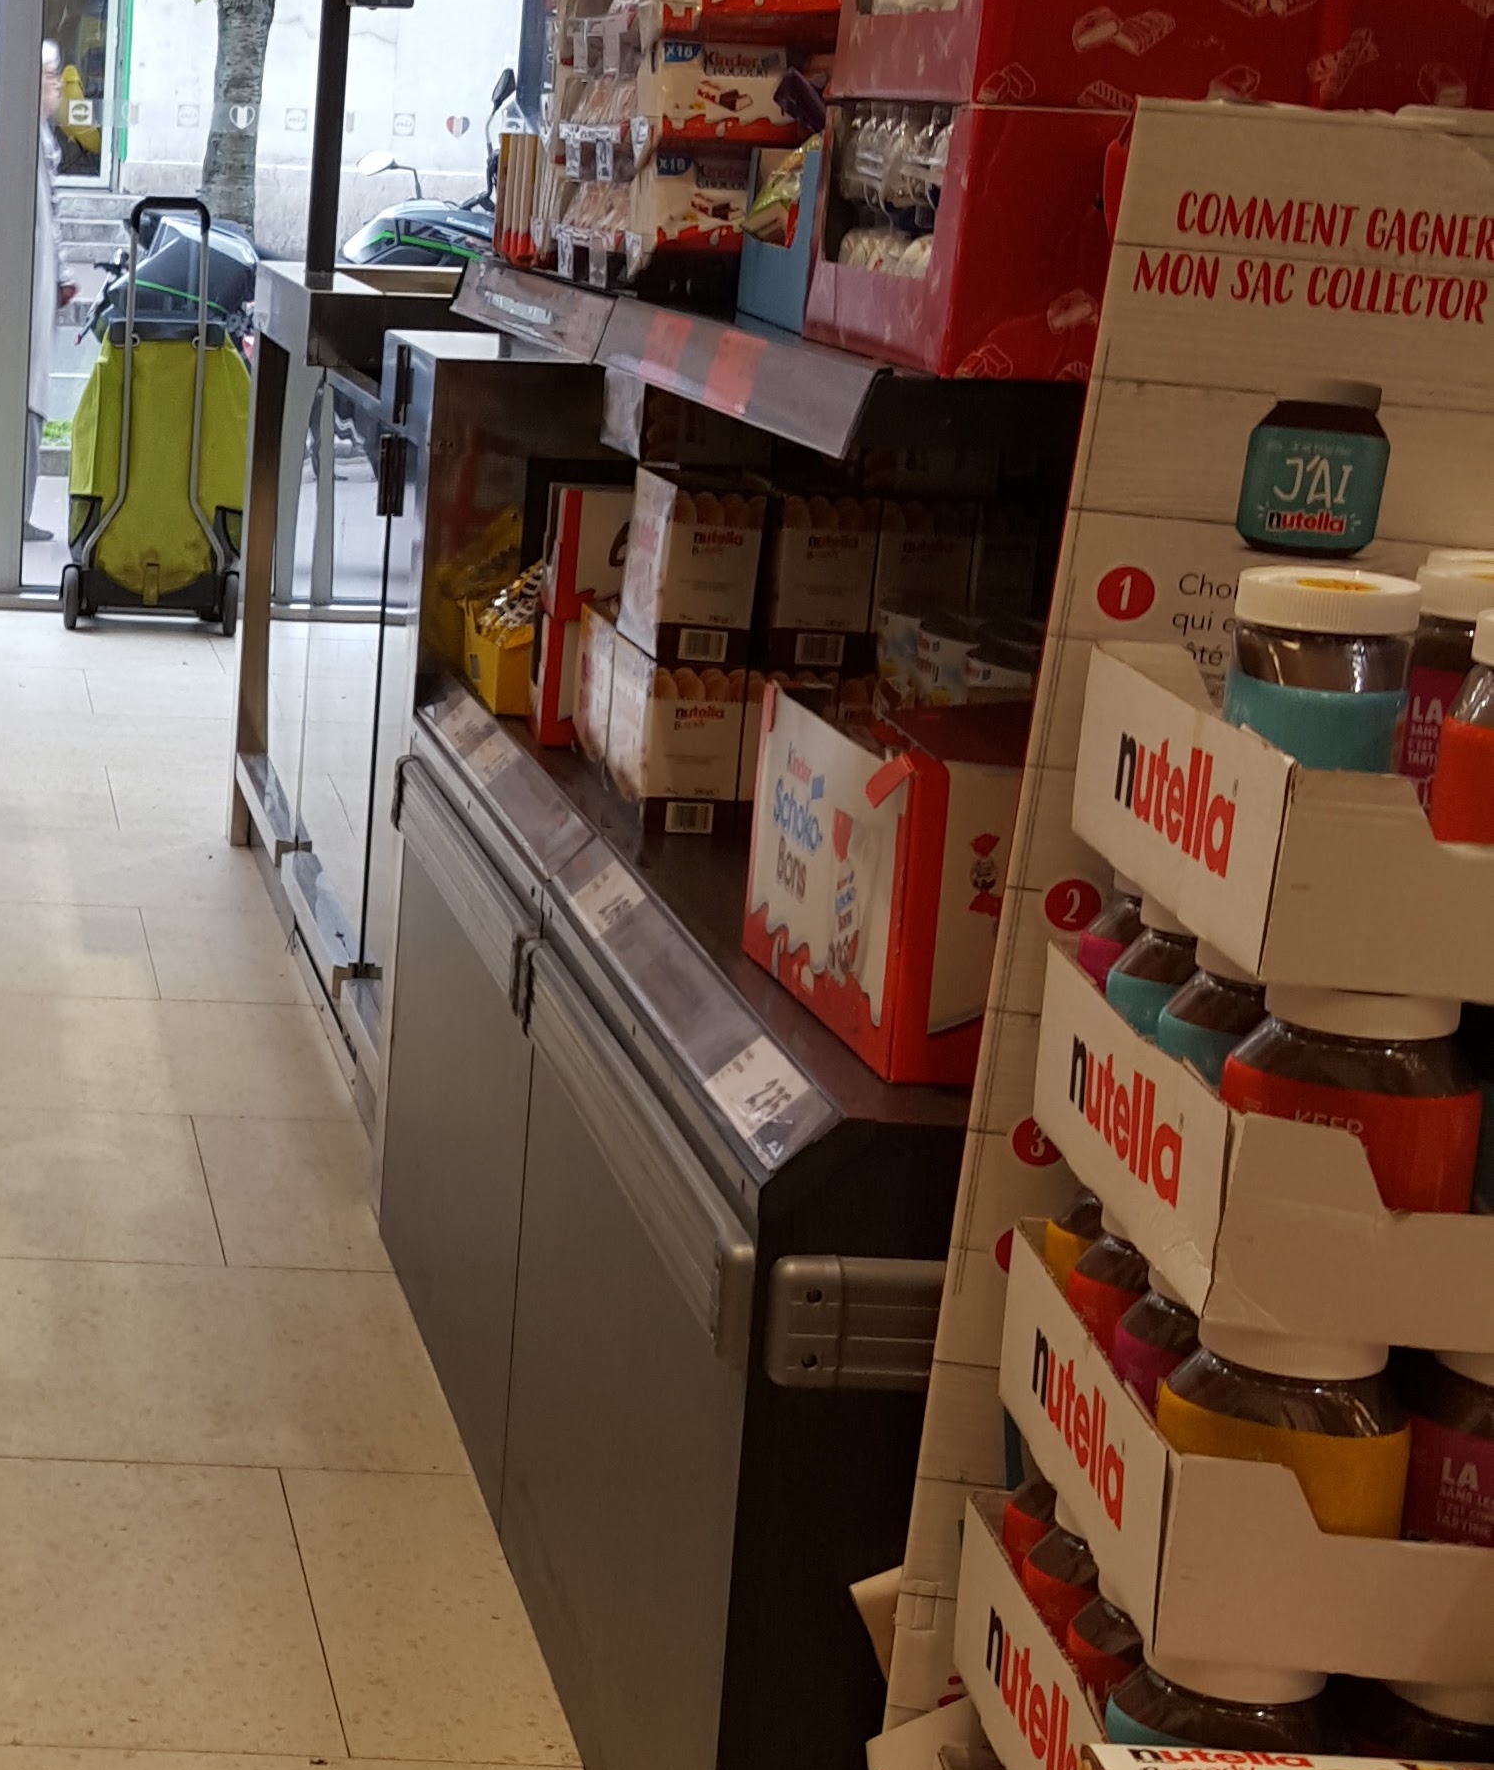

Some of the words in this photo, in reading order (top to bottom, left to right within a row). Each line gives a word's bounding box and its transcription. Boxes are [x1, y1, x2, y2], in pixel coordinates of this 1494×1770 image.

[1177, 190, 1359, 247] COMMENT
[1366, 207, 1494, 261] GAGNER
[1133, 251, 1219, 299] MON
[1230, 259, 1295, 306] SAC
[1307, 266, 1488, 324] COLLECTOR
[1273, 455, 1353, 509] J'AI
[1266, 510, 1346, 534] nutella
[1117, 574, 1133, 612] 1
[1179, 573, 1239, 599] Choi
[1173, 610, 1213, 637] qui
[1412, 695, 1443, 725] LA
[1114, 732, 1237, 878] nutella
[1064, 888, 1083, 923] 2
[1069, 1035, 1183, 1209] nutella
[1032, 1326, 1125, 1530] nutella
[1441, 1457, 1479, 1491] LA
[1128, 1747, 1314, 1768] nutella
